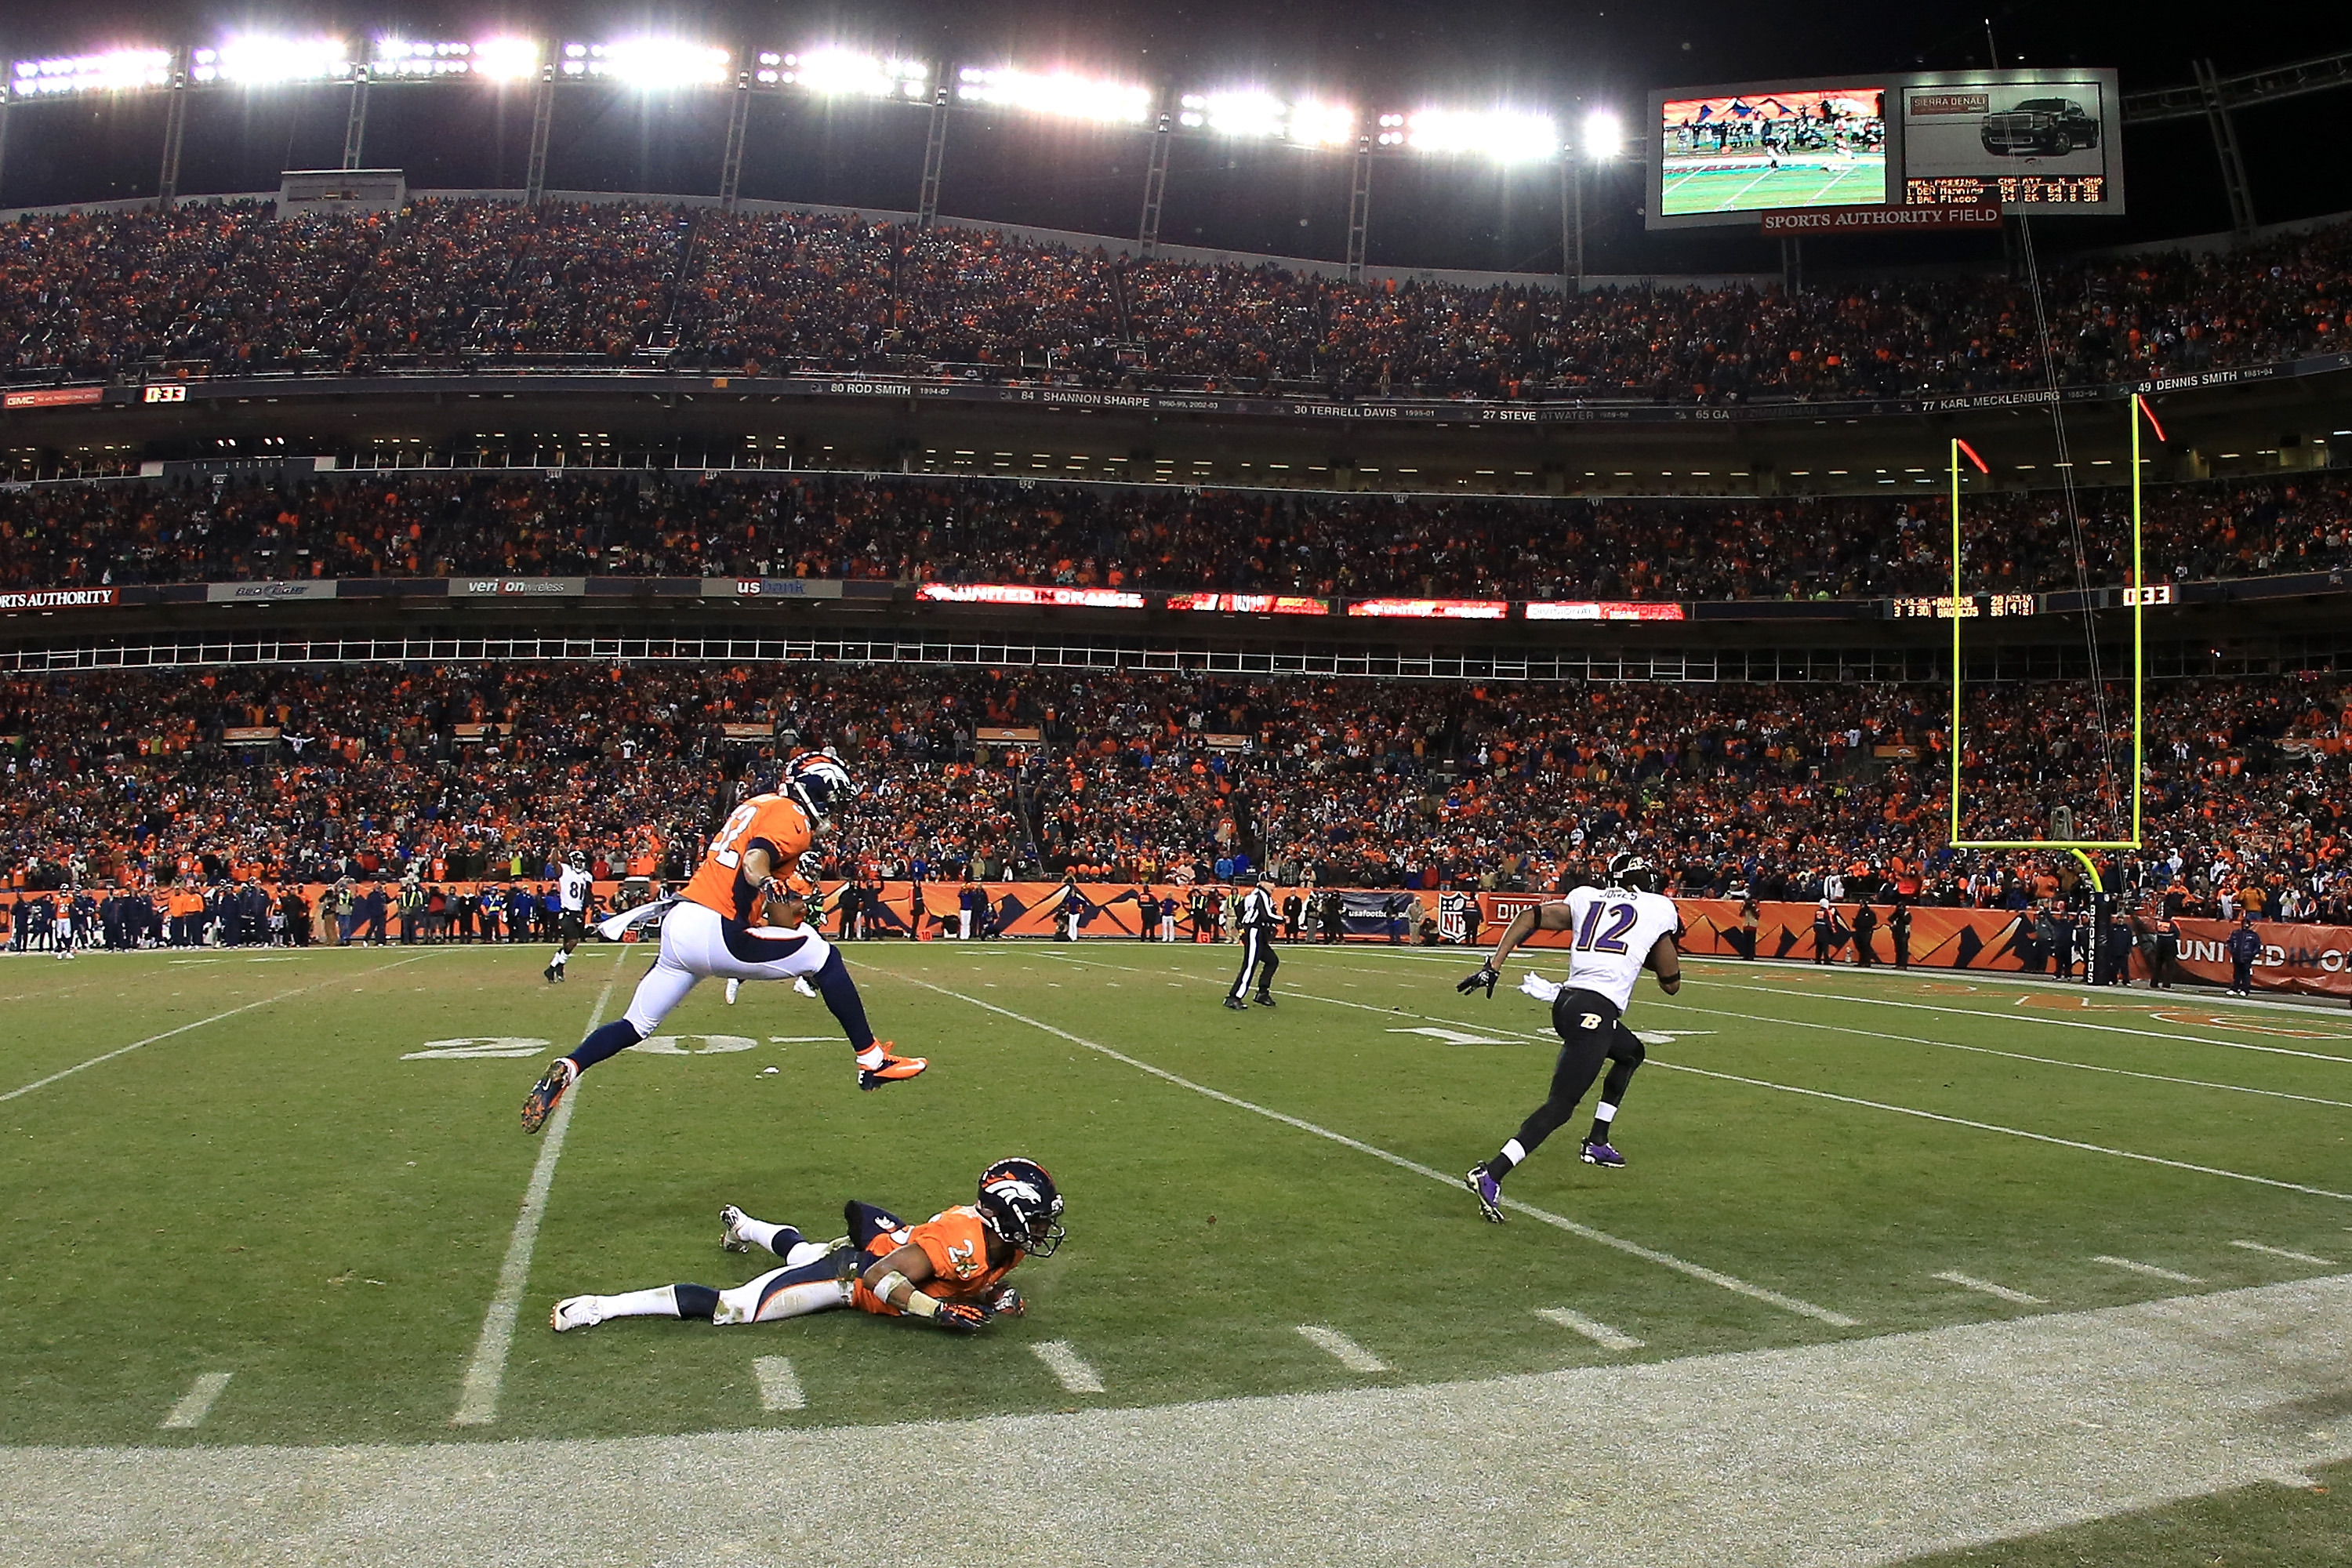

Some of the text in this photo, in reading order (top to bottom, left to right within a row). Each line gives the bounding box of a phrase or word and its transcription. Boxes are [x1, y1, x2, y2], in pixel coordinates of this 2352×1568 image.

[1914, 93, 1987, 107] SIERRA DENALI
[1765, 209, 1998, 229] SPORTS AUTHORITY FIELD
[831, 383, 844, 393] 80
[847, 384, 872, 394] ROD
[875, 384, 911, 395] SMITH
[2138, 382, 2151, 393] 49
[2156, 376, 2198, 390] DENNIS
[2201, 371, 2238, 385] SMITH
[7, 395, 35, 406] GMC
[1021, 390, 1034, 401] 84
[1044, 391, 1101, 405] SHANNON
[1103, 395, 1150, 408] SHARPE
[1922, 401, 1936, 412] 77
[1940, 398, 1970, 410] KARL
[1973, 390, 2060, 407] MECKLENBURG
[1294, 405, 1308, 415] 30
[1310, 405, 1361, 417] TERRELL
[1363, 408, 1397, 417] DAVIS
[1483, 410, 1497, 419] 27
[1500, 411, 1537, 421] STEVE
[1541, 411, 1594, 420] ATWATER
[1696, 410, 1709, 420] 65
[524, 582, 564, 593] wireless
[27, 589, 113, 607] AUTHORITY
[956, 586, 1142, 608] UNITED IN ORANGE
[1991, 595, 2004, 606] 28
[2123, 585, 2169, 607] 033
[1384, 604, 1432, 615] UNITED
[1532, 604, 1676, 617] DIVISIONAL PLAYOFFS
[1894, 606, 1901, 617] 3
[1907, 606, 1915, 617] 3
[1916, 605, 1929, 616] 30
[708, 803, 758, 869] 32
[569, 881, 585, 901] 81
[1443, 912, 1465, 932] NF
[1576, 901, 1638, 956] 12
[921, 931, 931, 940] 10
[2087, 904, 2096, 984] BRONCOS
